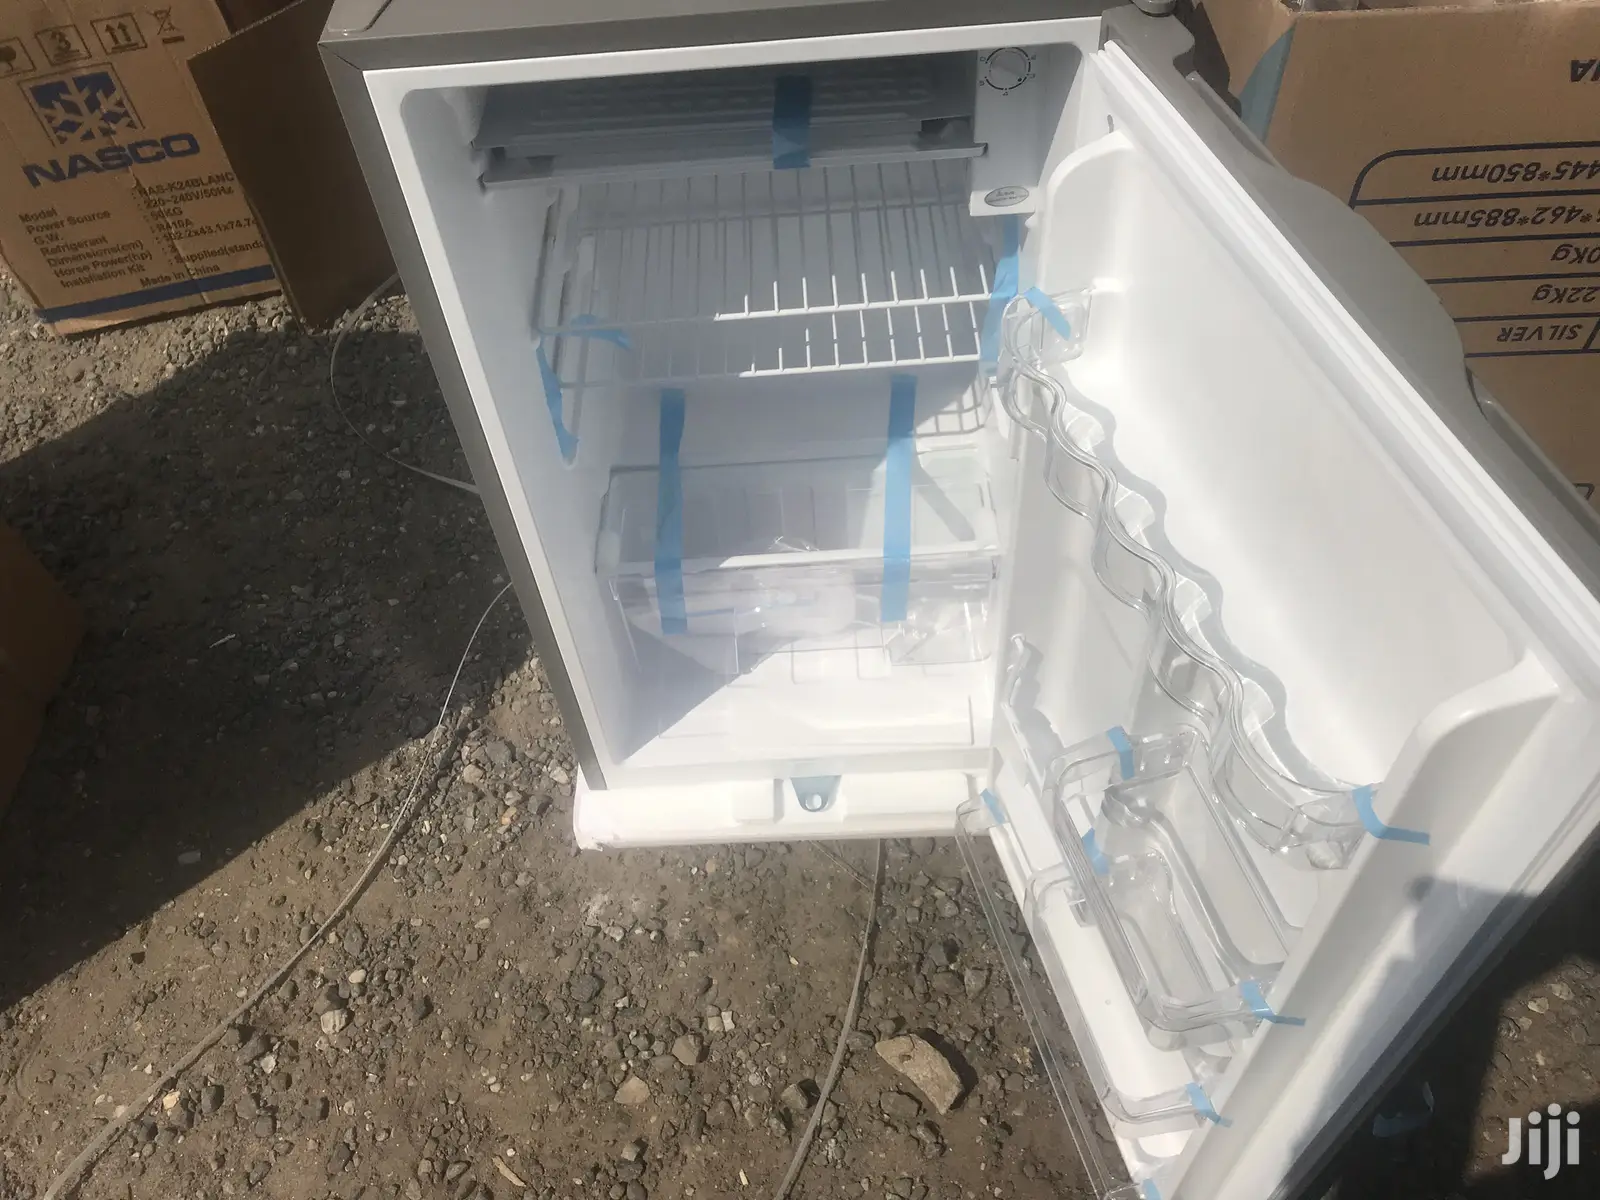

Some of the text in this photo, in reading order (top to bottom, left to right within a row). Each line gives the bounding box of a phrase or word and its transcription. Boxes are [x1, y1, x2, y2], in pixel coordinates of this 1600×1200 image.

[22, 132, 200, 189] NASCO
[19, 207, 58, 223] Model
[26, 219, 65, 235] Power
[67, 210, 111, 225] Source
[40, 235, 109, 257] Refrigerant
[53, 263, 90, 278] Horse
[60, 269, 126, 288] Installation
[127, 263, 146, 275] Kit
[140, 274, 172, 288] Made
[172, 270, 185, 280] in
[1532, 283, 1597, 305] 22Kg
[1496, 322, 1584, 343] SILVER
